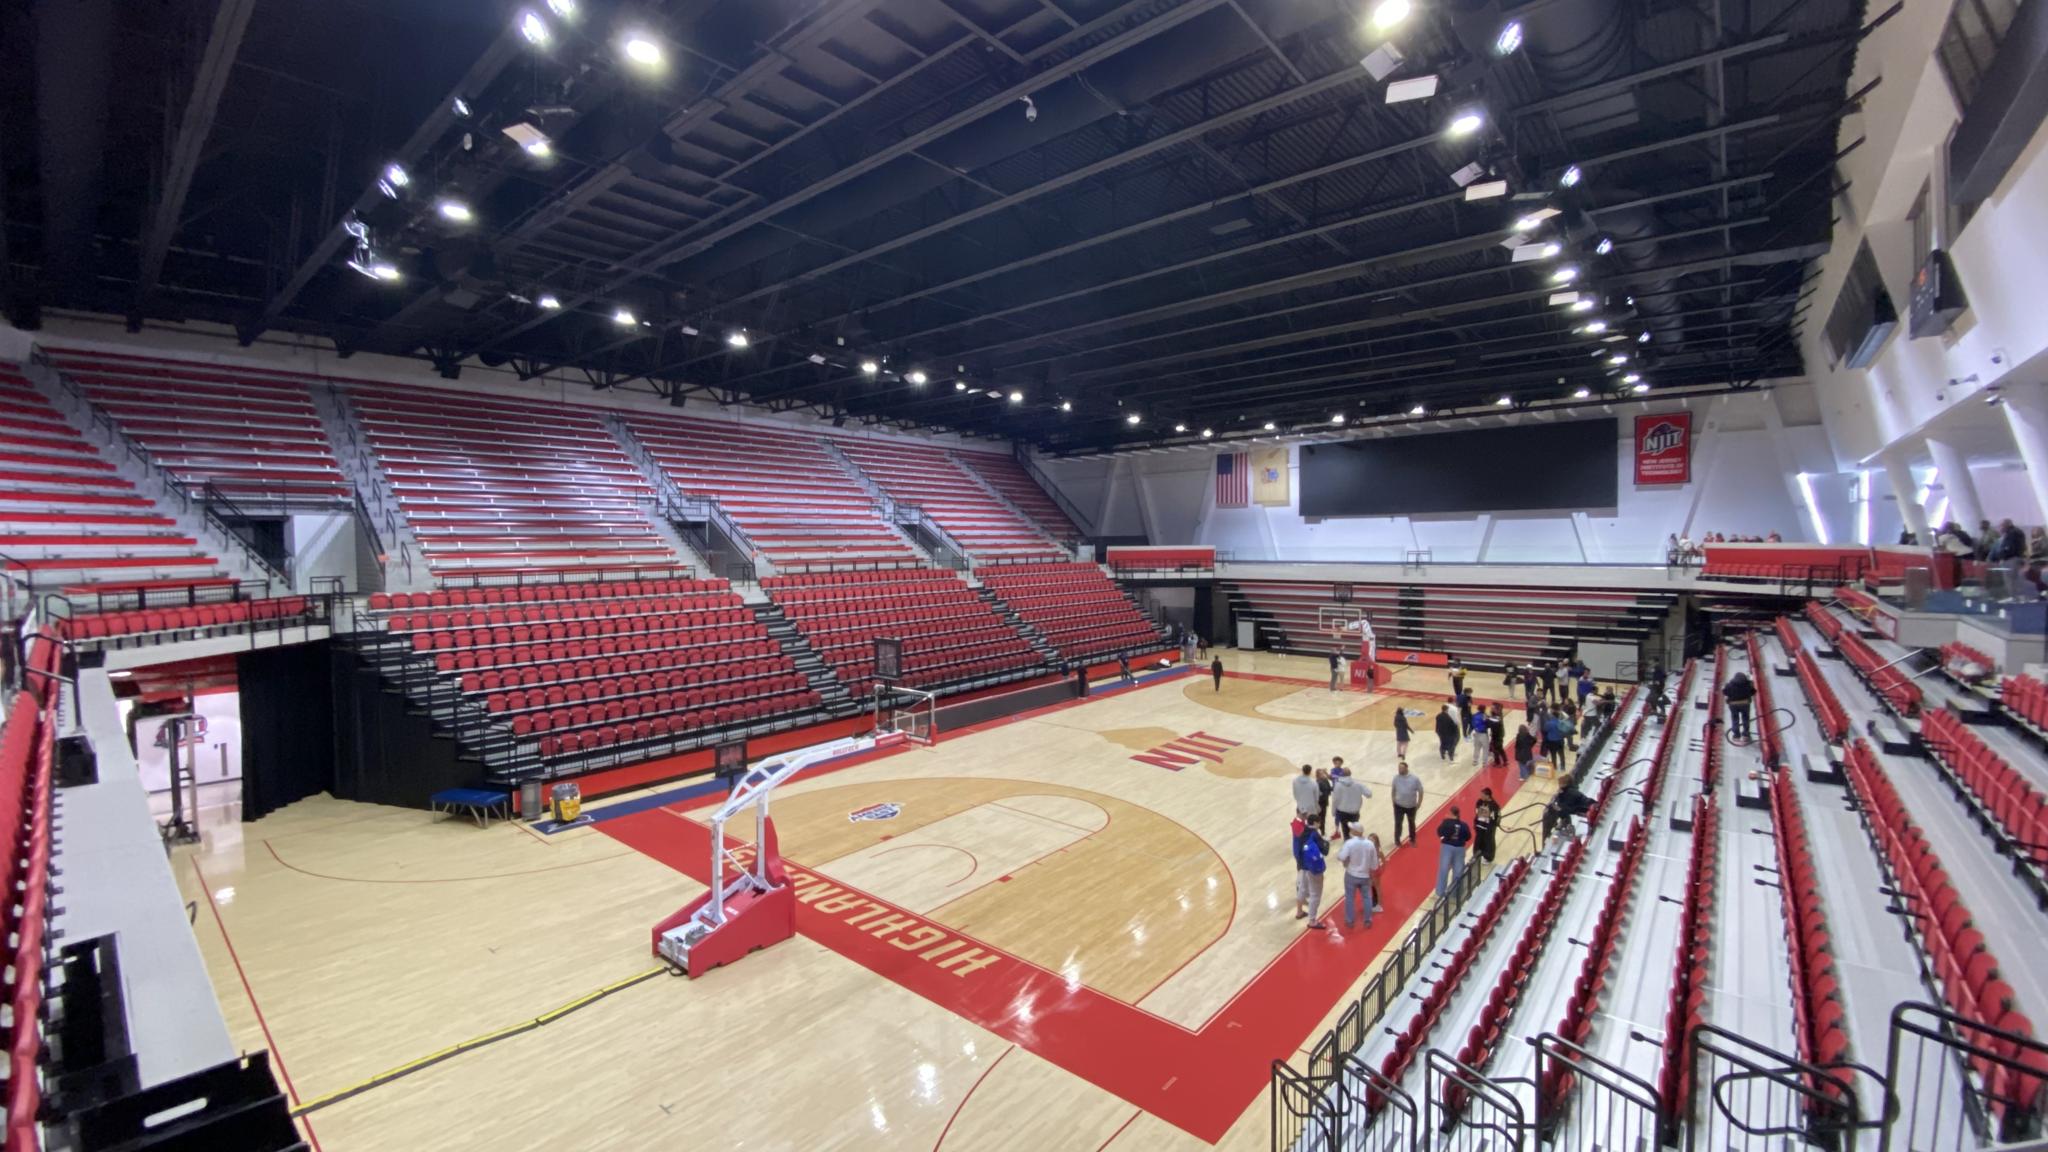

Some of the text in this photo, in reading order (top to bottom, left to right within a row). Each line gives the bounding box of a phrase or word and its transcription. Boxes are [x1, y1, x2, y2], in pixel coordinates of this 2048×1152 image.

[1646, 430, 1682, 452] NJIT
[1129, 730, 1244, 772] NJIT
[722, 847, 1001, 978] HIGHLANDS
